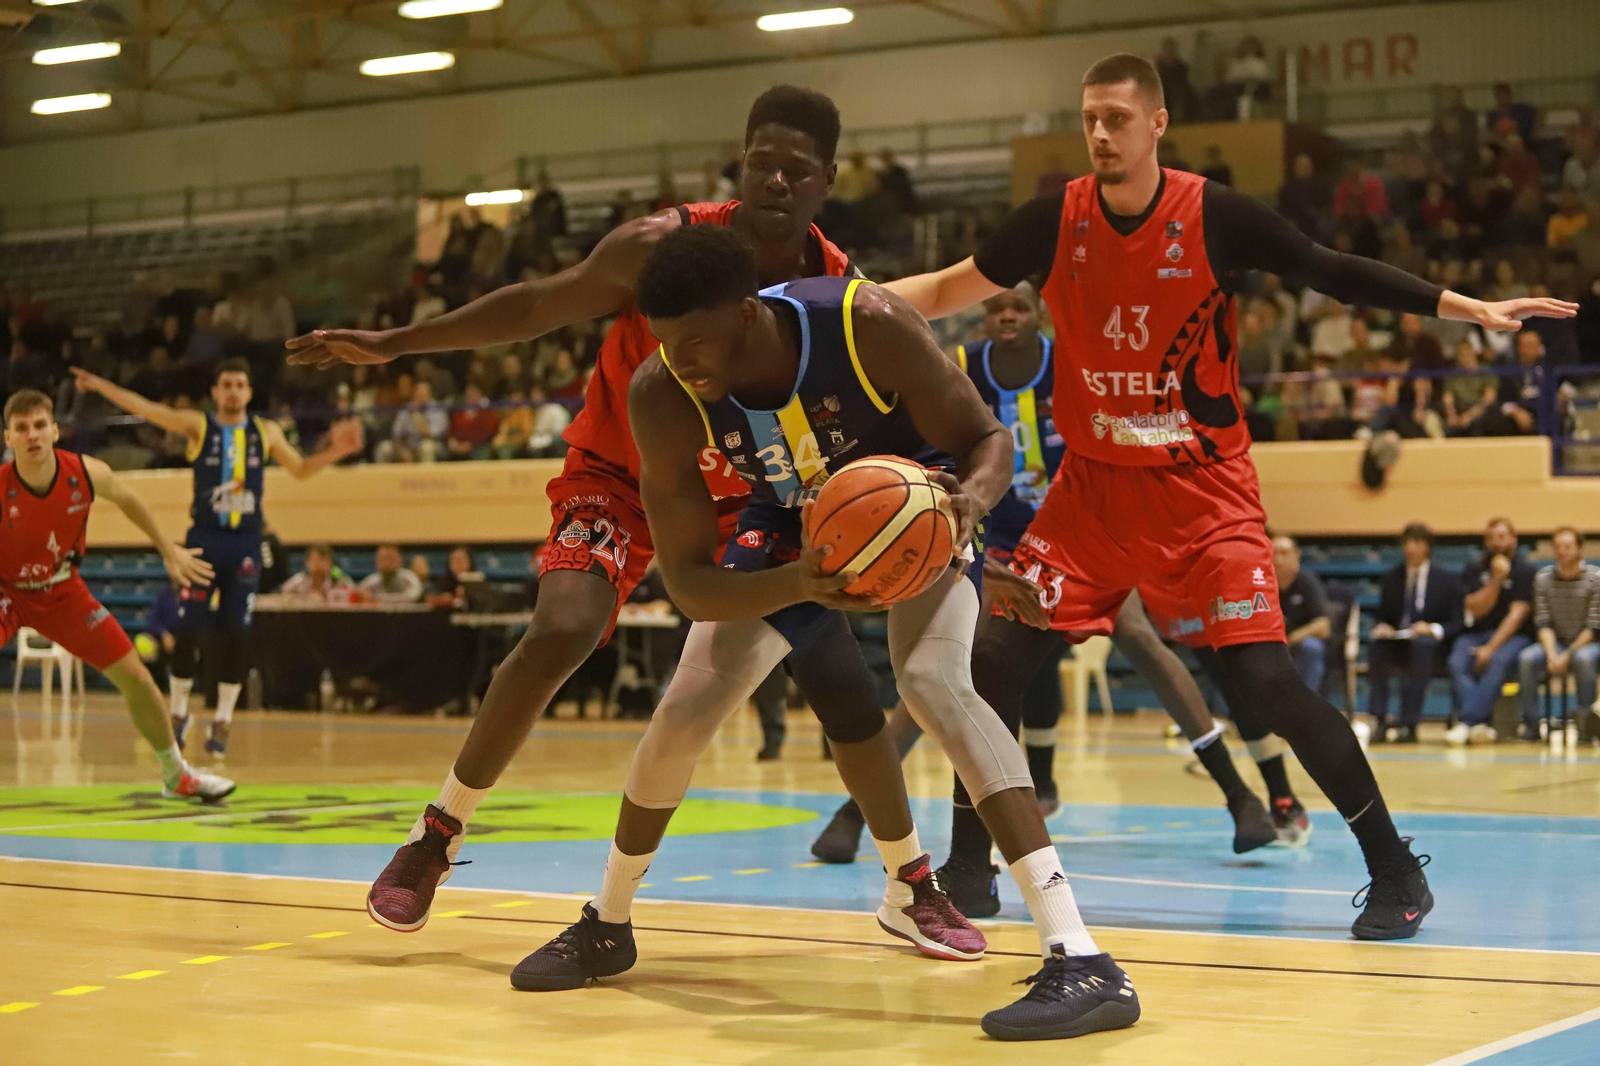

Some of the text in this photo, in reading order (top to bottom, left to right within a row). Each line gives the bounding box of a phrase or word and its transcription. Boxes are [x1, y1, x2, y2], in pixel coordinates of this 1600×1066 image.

[1103, 305, 1150, 351] 43
[755, 432, 830, 482] 34
[47, 531, 61, 563] 4
[590, 518, 631, 569] 23
